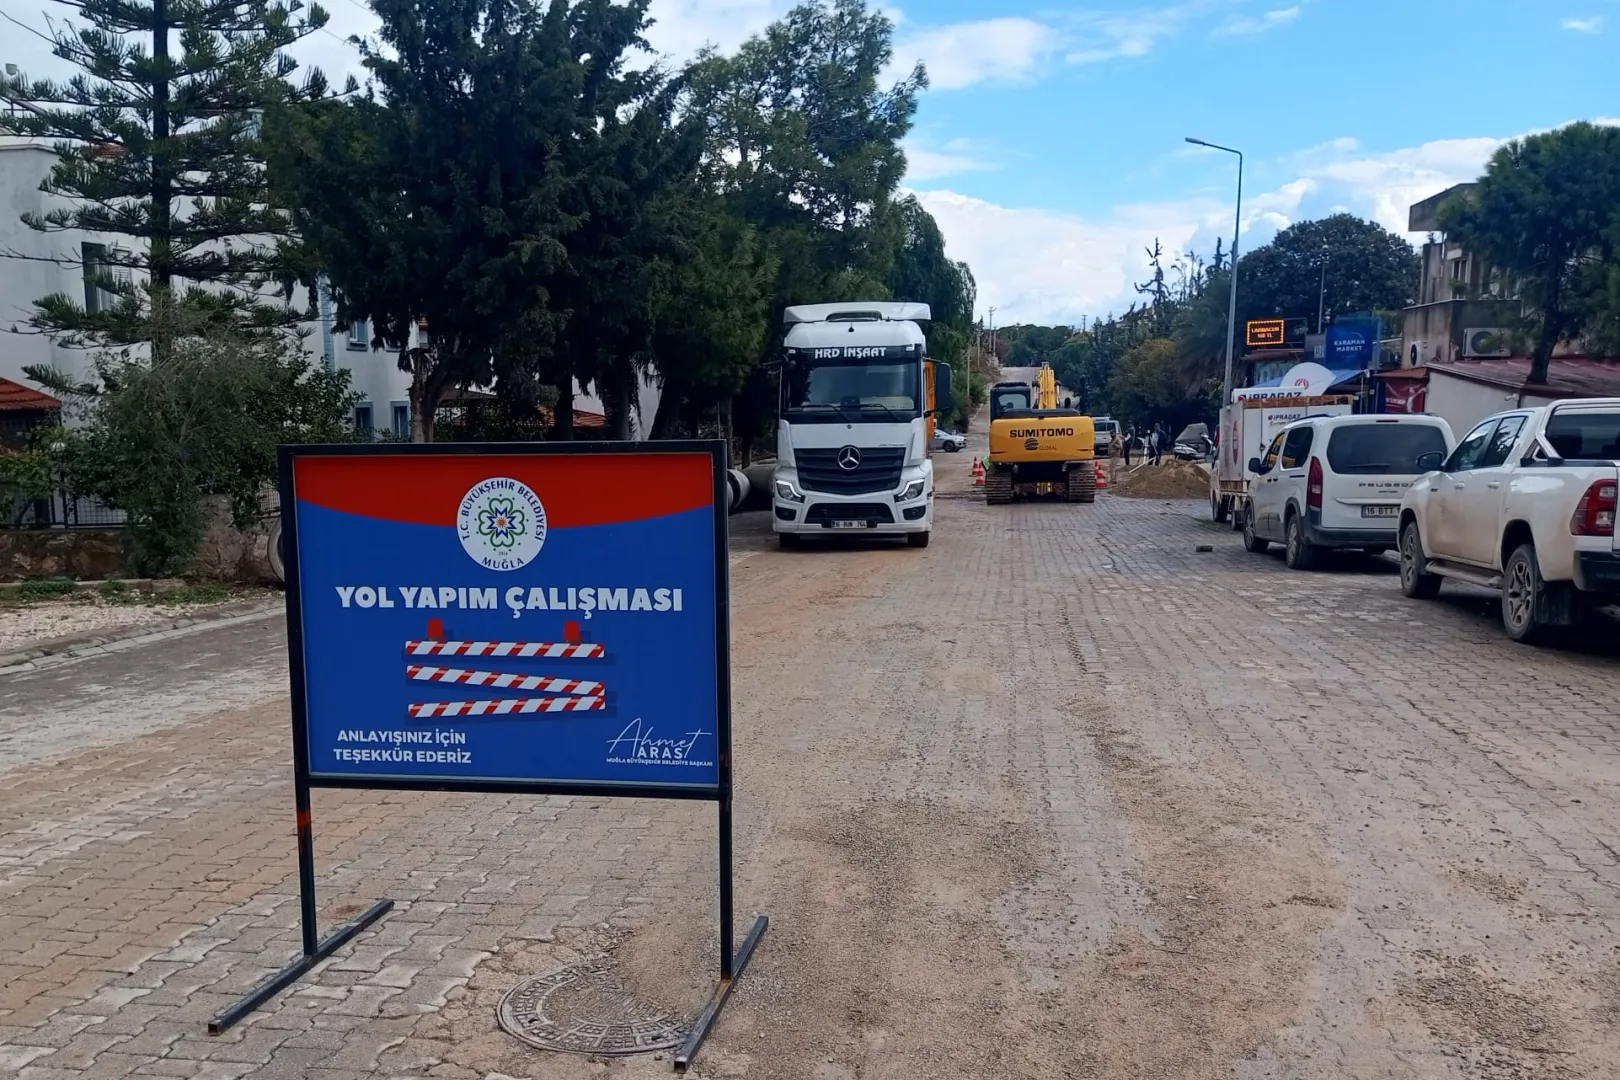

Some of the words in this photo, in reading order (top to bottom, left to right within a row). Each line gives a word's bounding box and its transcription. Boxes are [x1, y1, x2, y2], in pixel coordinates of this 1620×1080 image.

[814, 348, 840, 360] HRD
[843, 346, 887, 359] İNŞAAT
[1009, 427, 1074, 438] SUMITOMO
[461, 479, 516, 517] BÜYÜKŞEHİR
[517, 485, 546, 542] BELEDİYESİ
[1366, 507, 1376, 515] 16
[1378, 507, 1394, 515] BTT
[460, 520, 471, 541] T.C.
[481, 556, 525, 570] MUĞLA
[335, 586, 395, 608] YOL
[398, 586, 498, 610] YAPIM
[504, 587, 684, 620] ÇALIŞMASI
[337, 730, 433, 746] ANLAYIŞINIZ
[435, 728, 466, 747] İÇİN
[606, 717, 713, 759] Ahmet
[333, 747, 413, 764] TEŞEKKÜR
[416, 748, 472, 764] EDERİZ
[637, 746, 683, 759] ARAS
